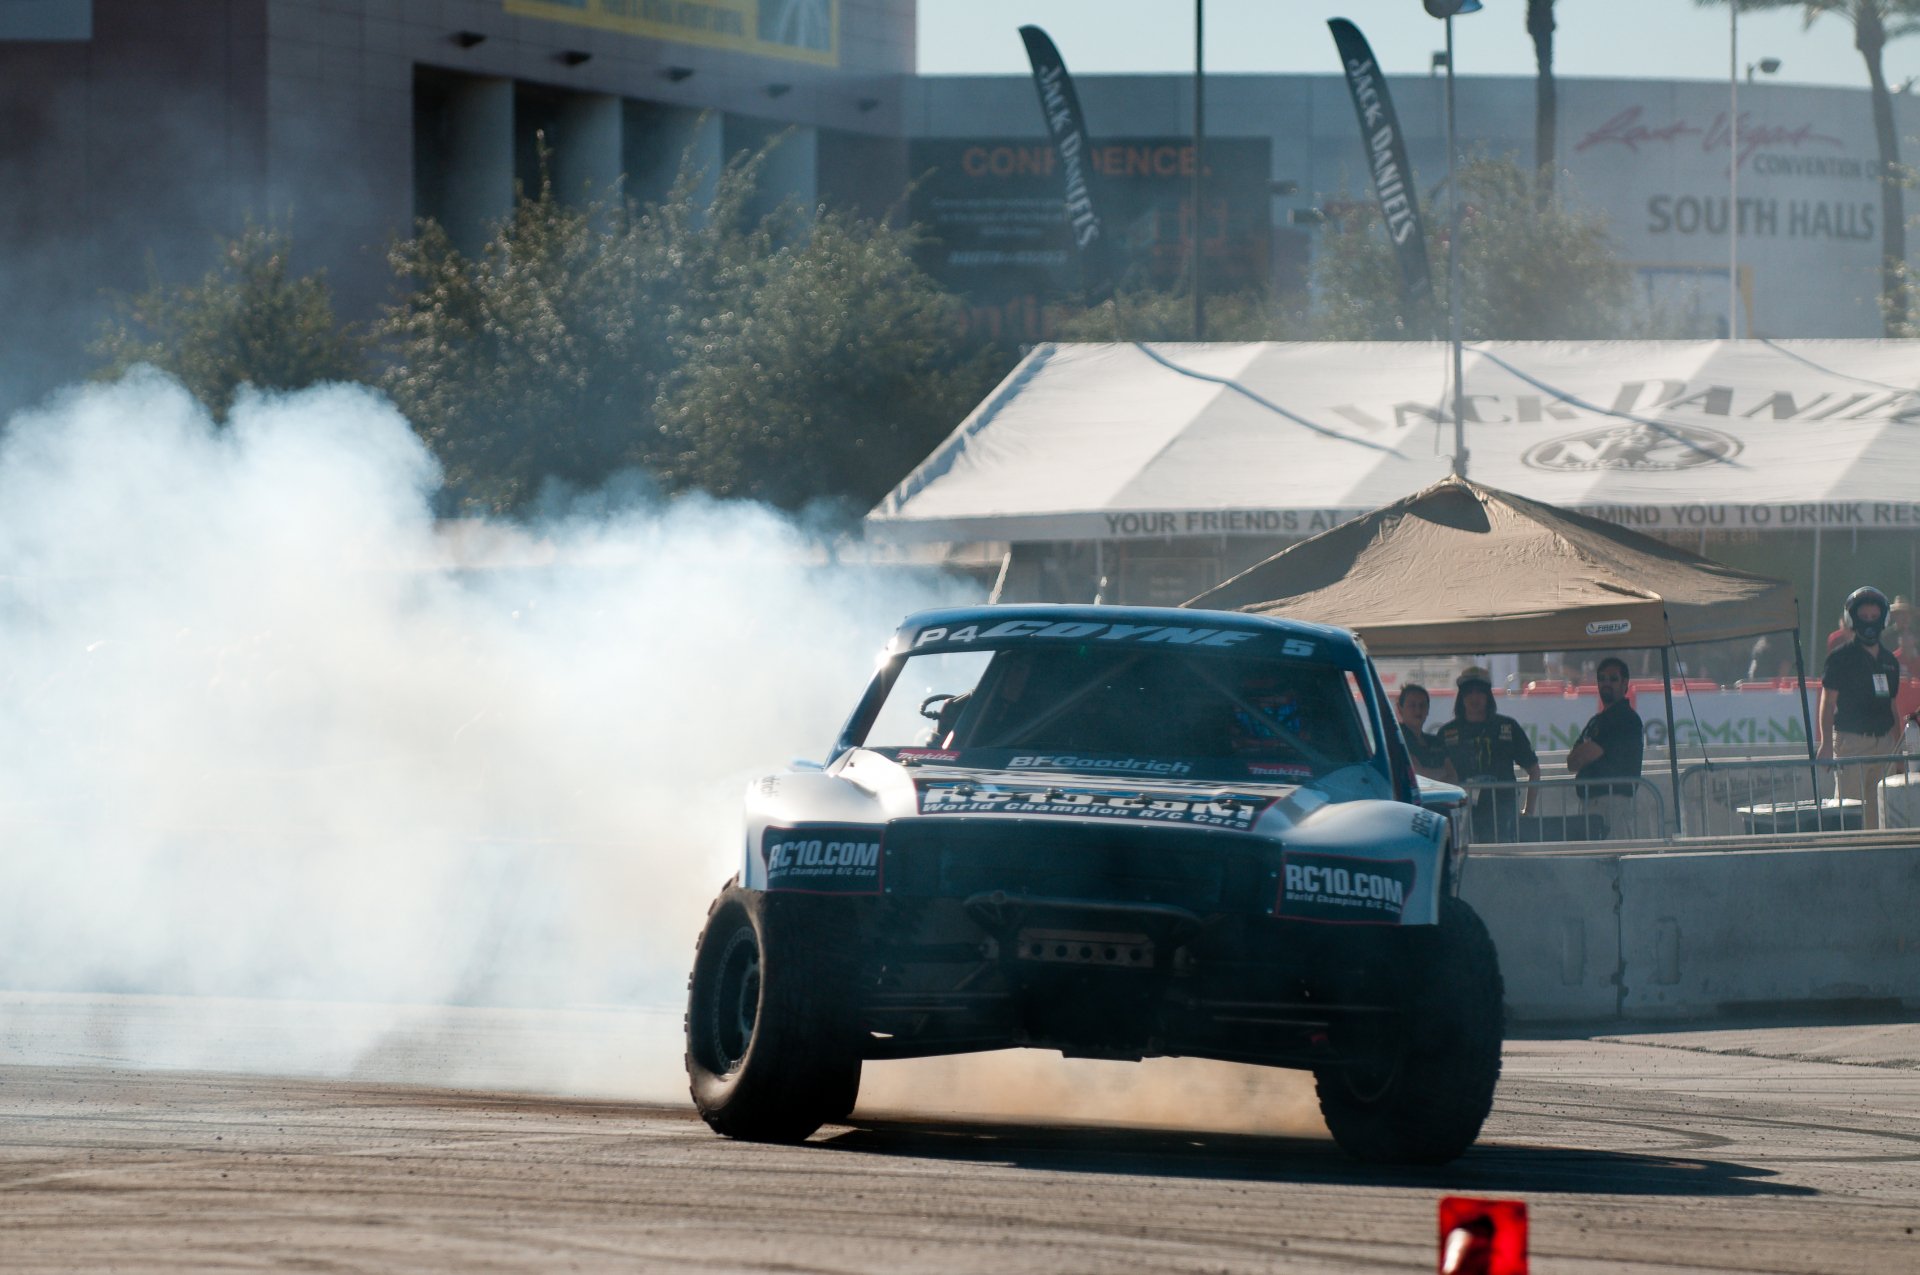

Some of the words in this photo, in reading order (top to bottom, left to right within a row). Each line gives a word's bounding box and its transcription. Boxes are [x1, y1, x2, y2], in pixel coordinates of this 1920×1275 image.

[1348, 57, 1385, 128] JACK
[1753, 153, 1862, 179] CONVENTION
[1647, 194, 1779, 237] SOUTH
[1789, 200, 1876, 241] HALLS
[1104, 510, 1178, 535] YOUR
[1186, 509, 1299, 532] FRIENDS
[1309, 509, 1341, 531] AT
[1565, 504, 1662, 526] EMIND
[1672, 504, 1727, 526] YOU
[1738, 503, 1772, 526] TO
[1779, 503, 1865, 525] DRINK
[914, 625, 980, 648] P4
[978, 621, 1260, 647] COYNE
[1282, 639, 1318, 657] 5
[1007, 755, 1191, 774] BFGoodrich
[922, 803, 993, 814] World
[1003, 801, 1129, 818] Champion
[1138, 808, 1185, 820] R/C
[1192, 813, 1251, 829] Cars
[767, 840, 881, 871] RC10.COM
[789, 866, 834, 877] Champion
[835, 867, 854, 876] R/C
[855, 867, 877, 877] Cars
[1284, 863, 1403, 905] RC10.COM
[1286, 891, 1316, 902] World
[1317, 894, 1363, 908] Champion
[1366, 899, 1383, 909] R/C
